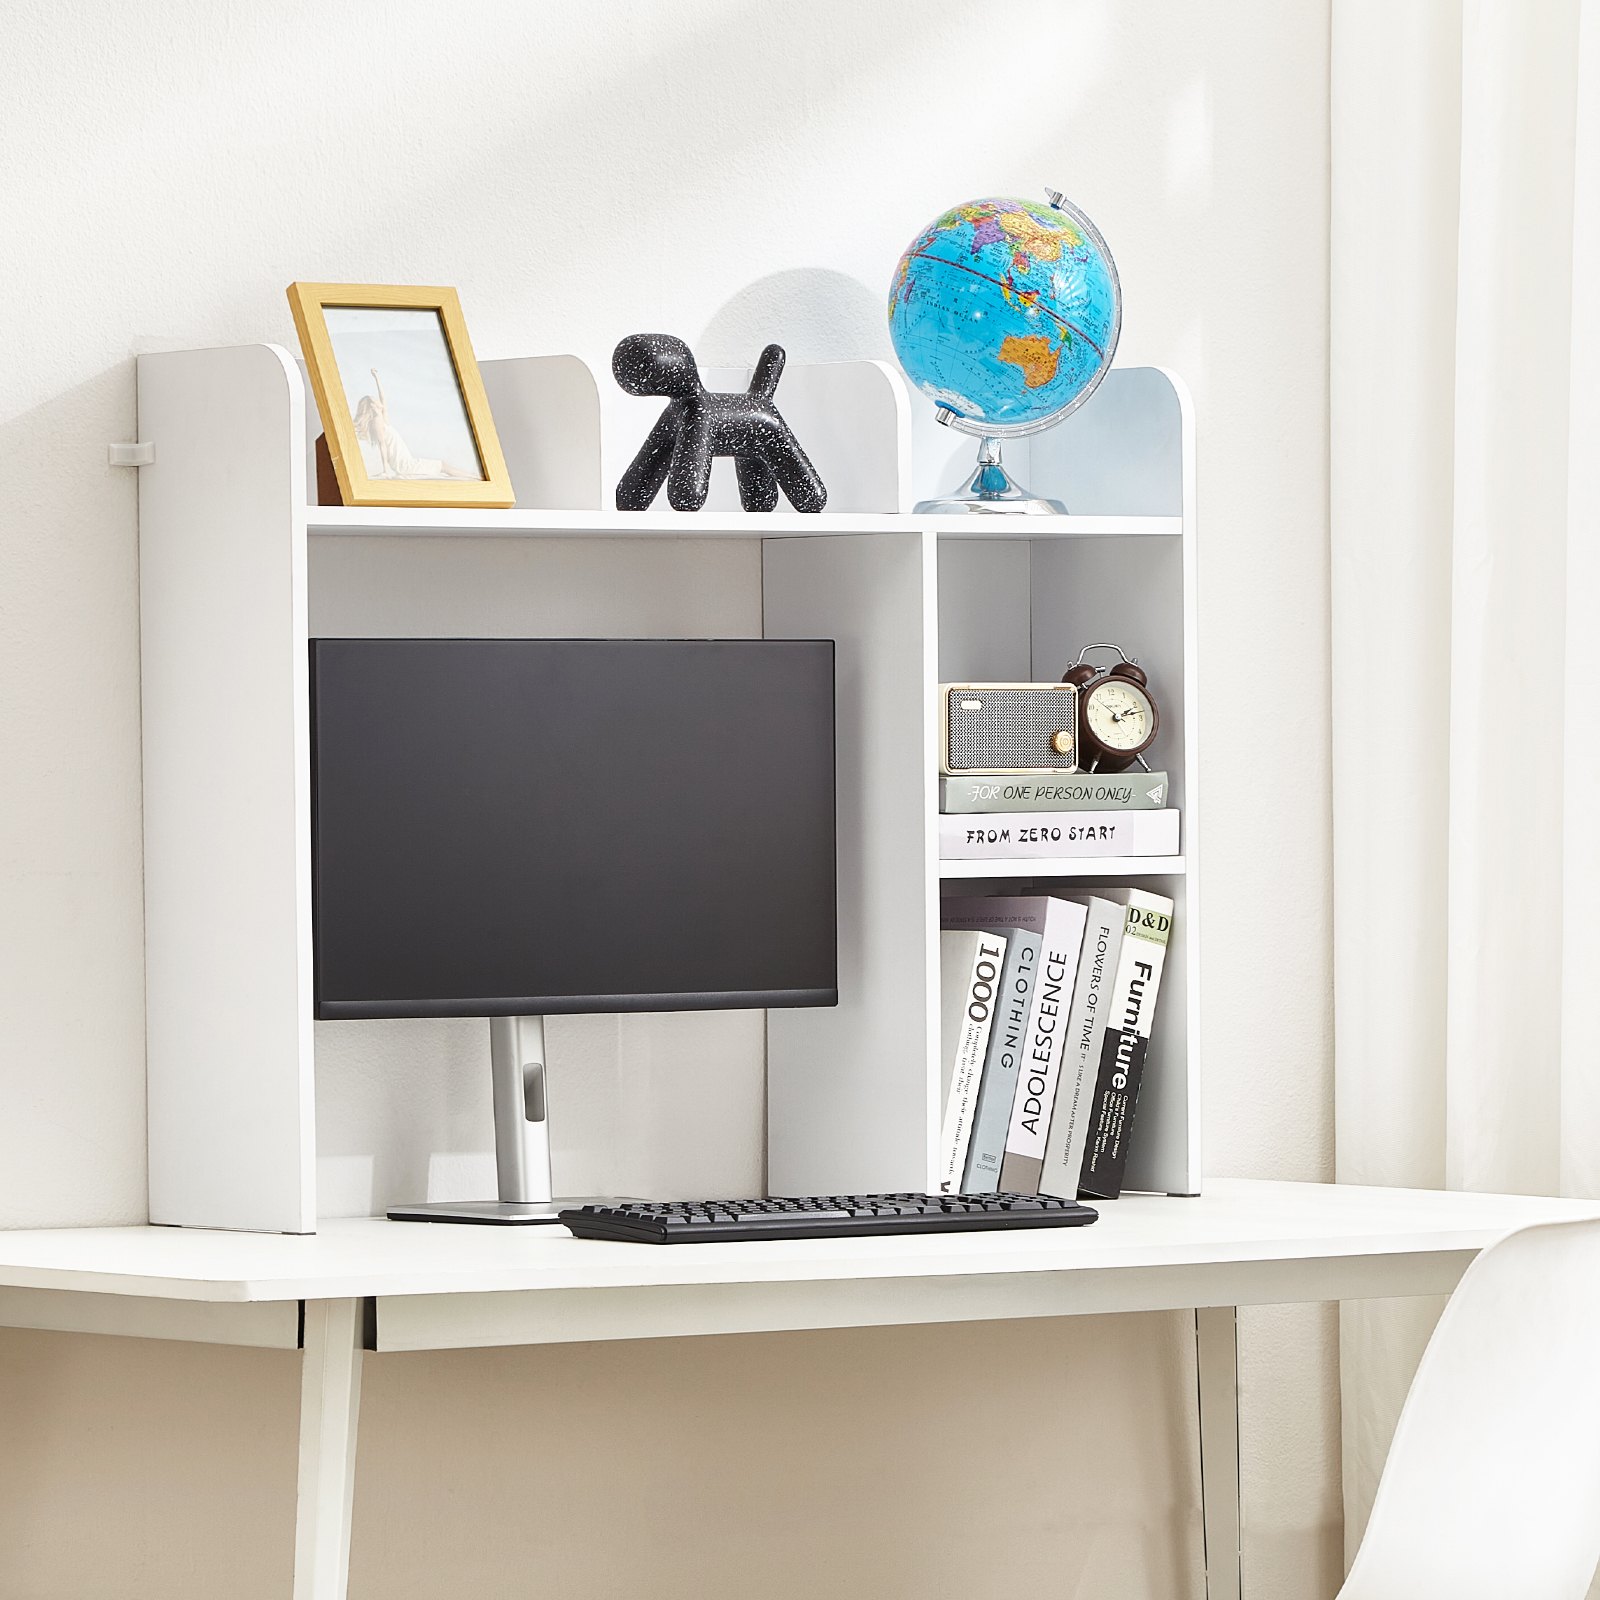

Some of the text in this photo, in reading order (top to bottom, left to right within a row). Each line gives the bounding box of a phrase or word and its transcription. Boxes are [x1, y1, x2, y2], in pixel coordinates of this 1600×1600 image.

[1003, 786, 1032, 800] ONE
[1034, 786, 1093, 801] PERSON
[966, 826, 1116, 844] FROM ZERO START
[1125, 925, 1137, 936] 02
[968, 943, 1000, 1023] 1000
[1079, 926, 1110, 1051] FLOWERS OF TIME
[1001, 947, 1035, 1069] CLOTHING
[1111, 960, 1153, 1090] Furniture
[1021, 951, 1067, 1136] ADOLESCENCE
[1071, 1087, 1080, 1111] DREAM
[1102, 1090, 1111, 1111] Special
[1097, 1110, 1107, 1131] Feature
[1100, 1091, 1117, 1153] Office Furniture System
[1110, 1111, 1119, 1136] Furniture
[1112, 1095, 1129, 1160] Current Furniture Design
[1062, 1130, 1073, 1167] PROSPERITY
[1090, 1152, 1099, 1172] Rashid
